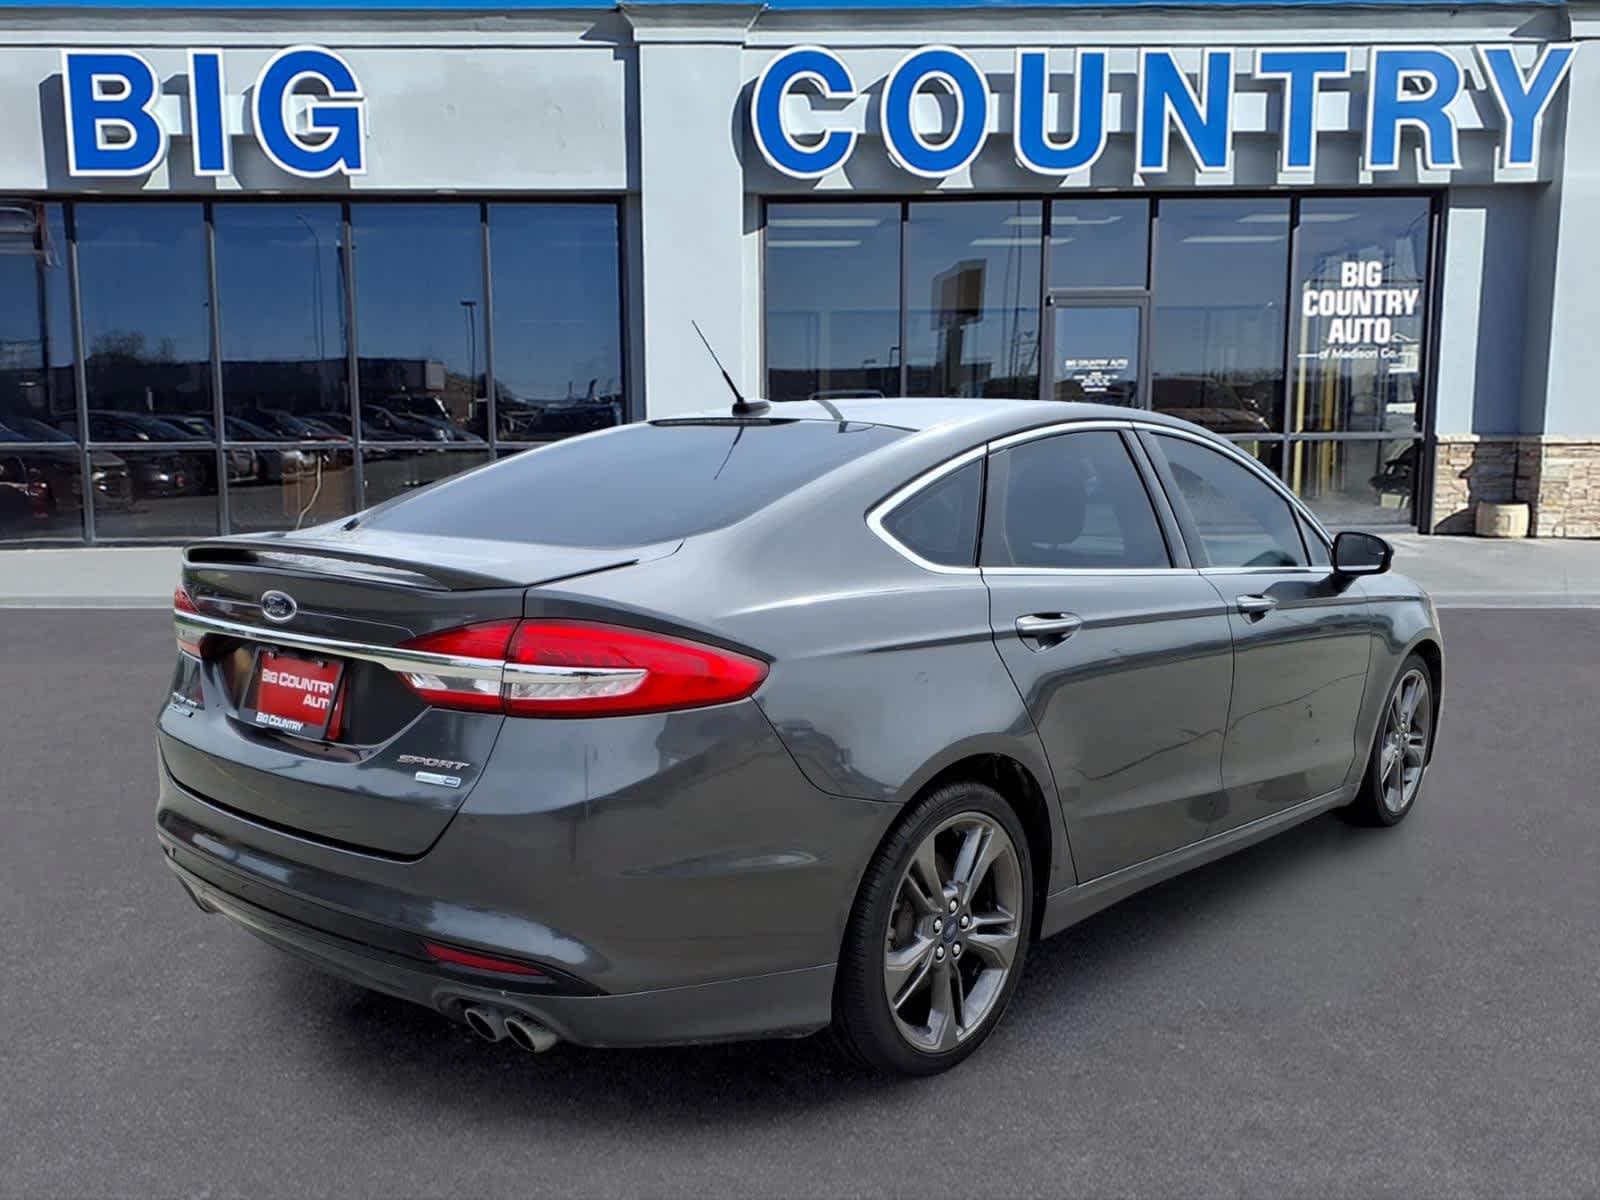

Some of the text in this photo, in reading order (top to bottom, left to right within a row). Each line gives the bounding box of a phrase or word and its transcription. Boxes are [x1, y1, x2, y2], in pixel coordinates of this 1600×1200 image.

[60, 43, 1574, 180] BIG COUNTRY
[1341, 261, 1382, 288] BIG
[1302, 289, 1419, 316] COUNTRY
[1328, 317, 1391, 344] AUTO
[303, 694, 337, 711] AUT
[269, 714, 304, 731] COUNTRY
[397, 755, 470, 770] SPORT
